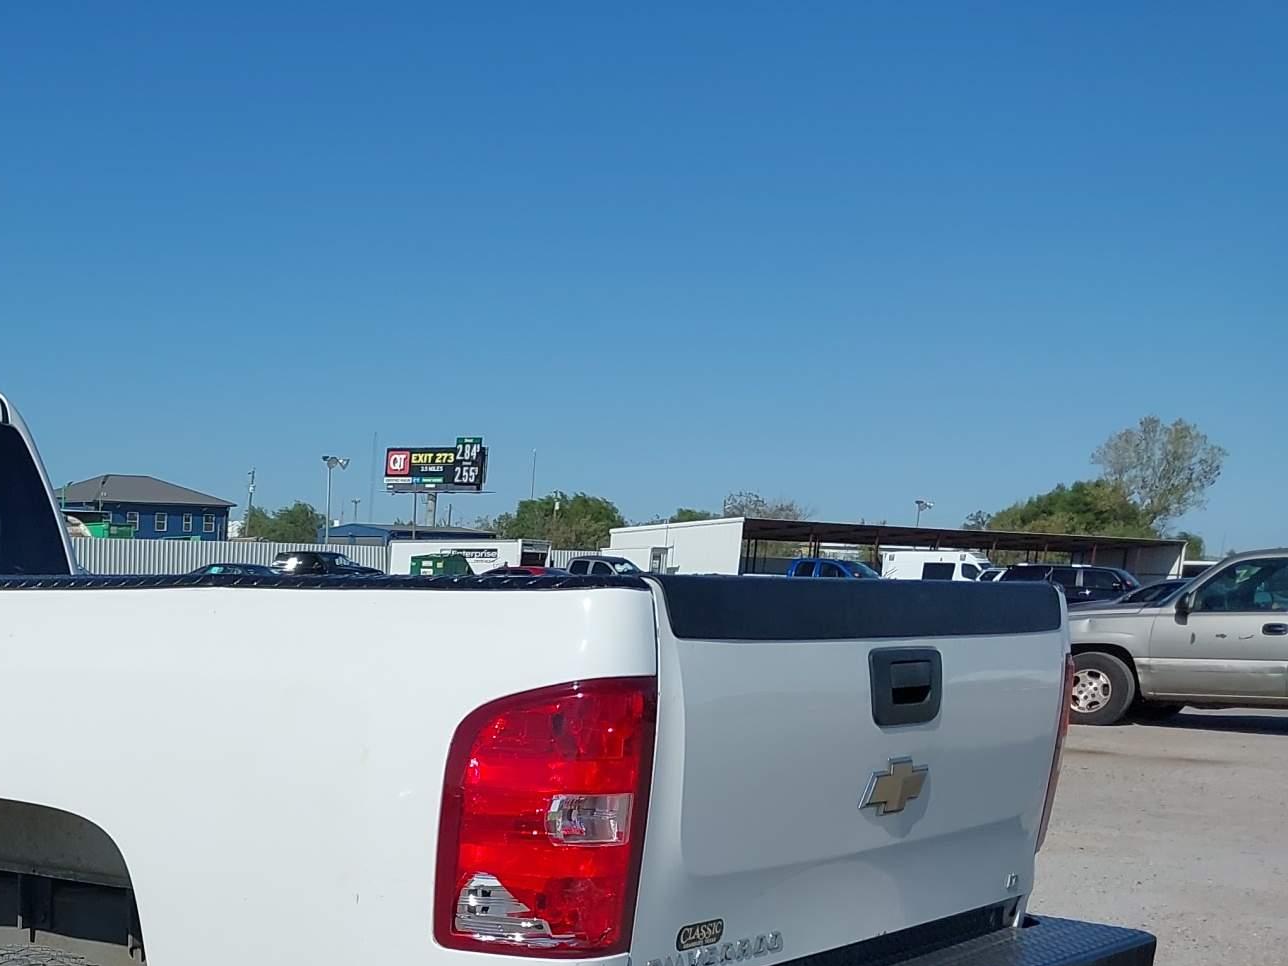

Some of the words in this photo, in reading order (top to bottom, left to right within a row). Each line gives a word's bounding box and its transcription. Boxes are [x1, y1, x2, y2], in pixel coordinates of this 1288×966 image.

[389, 454, 407, 472] QT
[411, 453, 434, 463] EXIT
[435, 453, 455, 463] 273
[451, 549, 498, 559] Enterprise
[680, 921, 723, 945] CLASSIC
